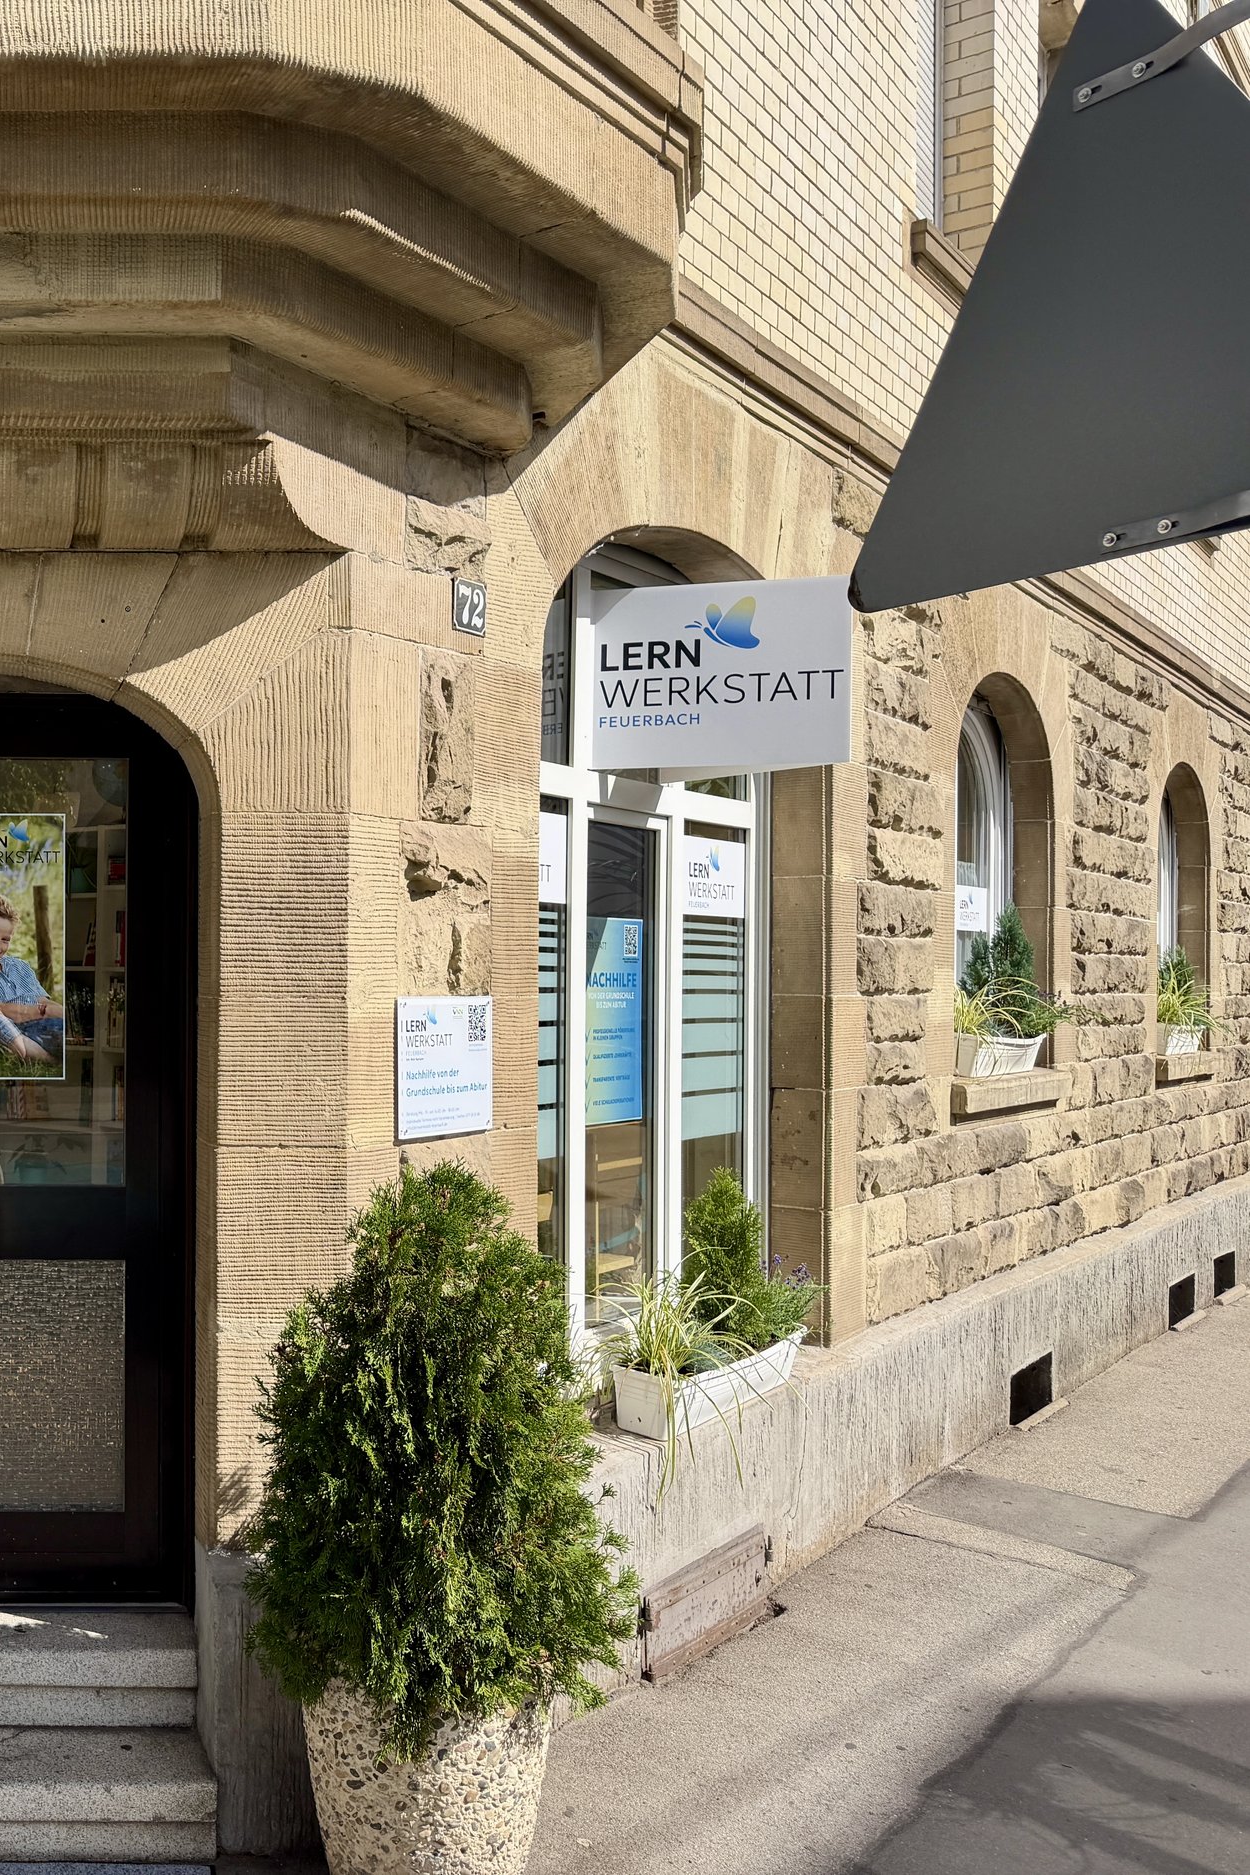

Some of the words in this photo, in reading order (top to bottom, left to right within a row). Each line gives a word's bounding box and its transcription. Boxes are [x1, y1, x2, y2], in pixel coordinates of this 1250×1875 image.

[457, 585, 485, 628] 72
[601, 638, 701, 672] LERN
[600, 669, 845, 708] WERKSTATT
[599, 713, 701, 728] FEUERBACH
[688, 861, 710, 879] LERN
[688, 881, 735, 901] WERKSTATT
[586, 972, 637, 988] NACHHILFE
[405, 1020, 427, 1032] LERN
[406, 1034, 453, 1047] WERKSTATT
[406, 1069, 436, 1080] Nachhilfe
[437, 1070, 448, 1078] von
[449, 1068, 459, 1077] der
[406, 1085, 446, 1097] Grundschule
[447, 1084, 455, 1093] bis
[456, 1085, 469, 1093] zum
[469, 1082, 488, 1091] Abitur
